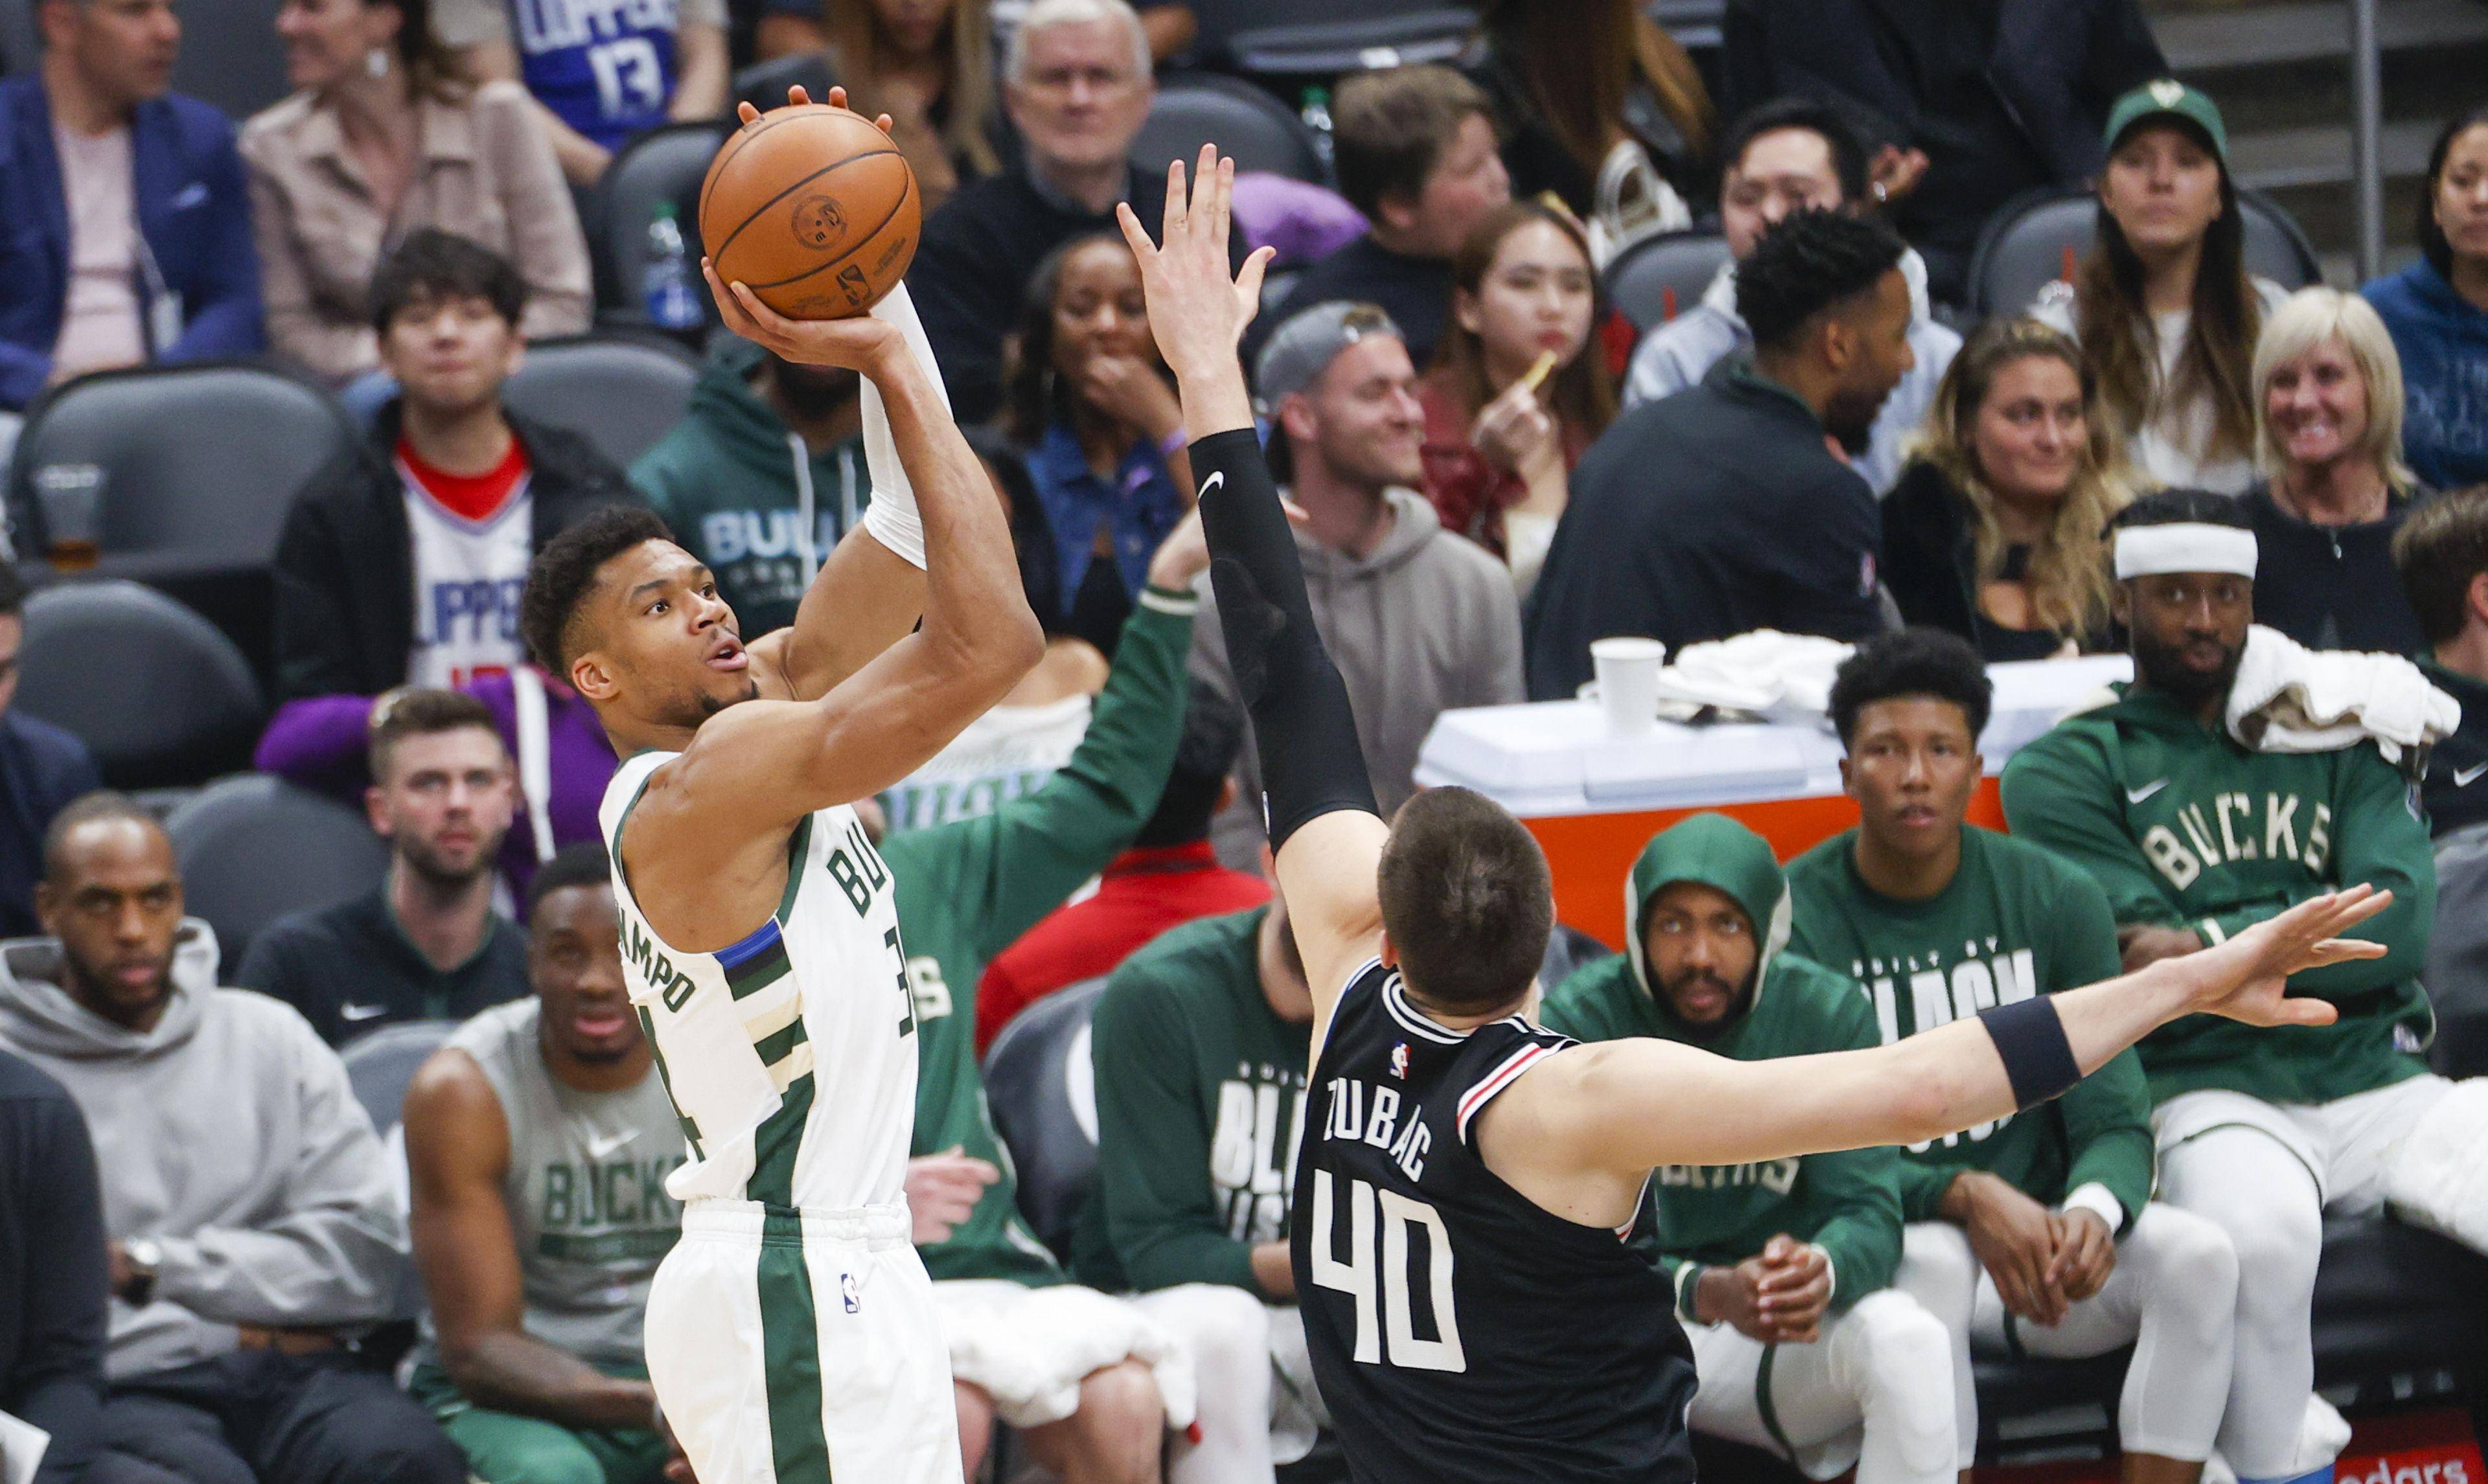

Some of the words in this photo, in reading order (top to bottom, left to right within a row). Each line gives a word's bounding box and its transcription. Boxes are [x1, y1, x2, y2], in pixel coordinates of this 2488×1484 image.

[586, 37, 662, 119] 13
[1323, 1077, 1433, 1183] ZUBAC
[543, 1156, 688, 1226] BUCK
[1311, 1168, 1468, 1373] 40
